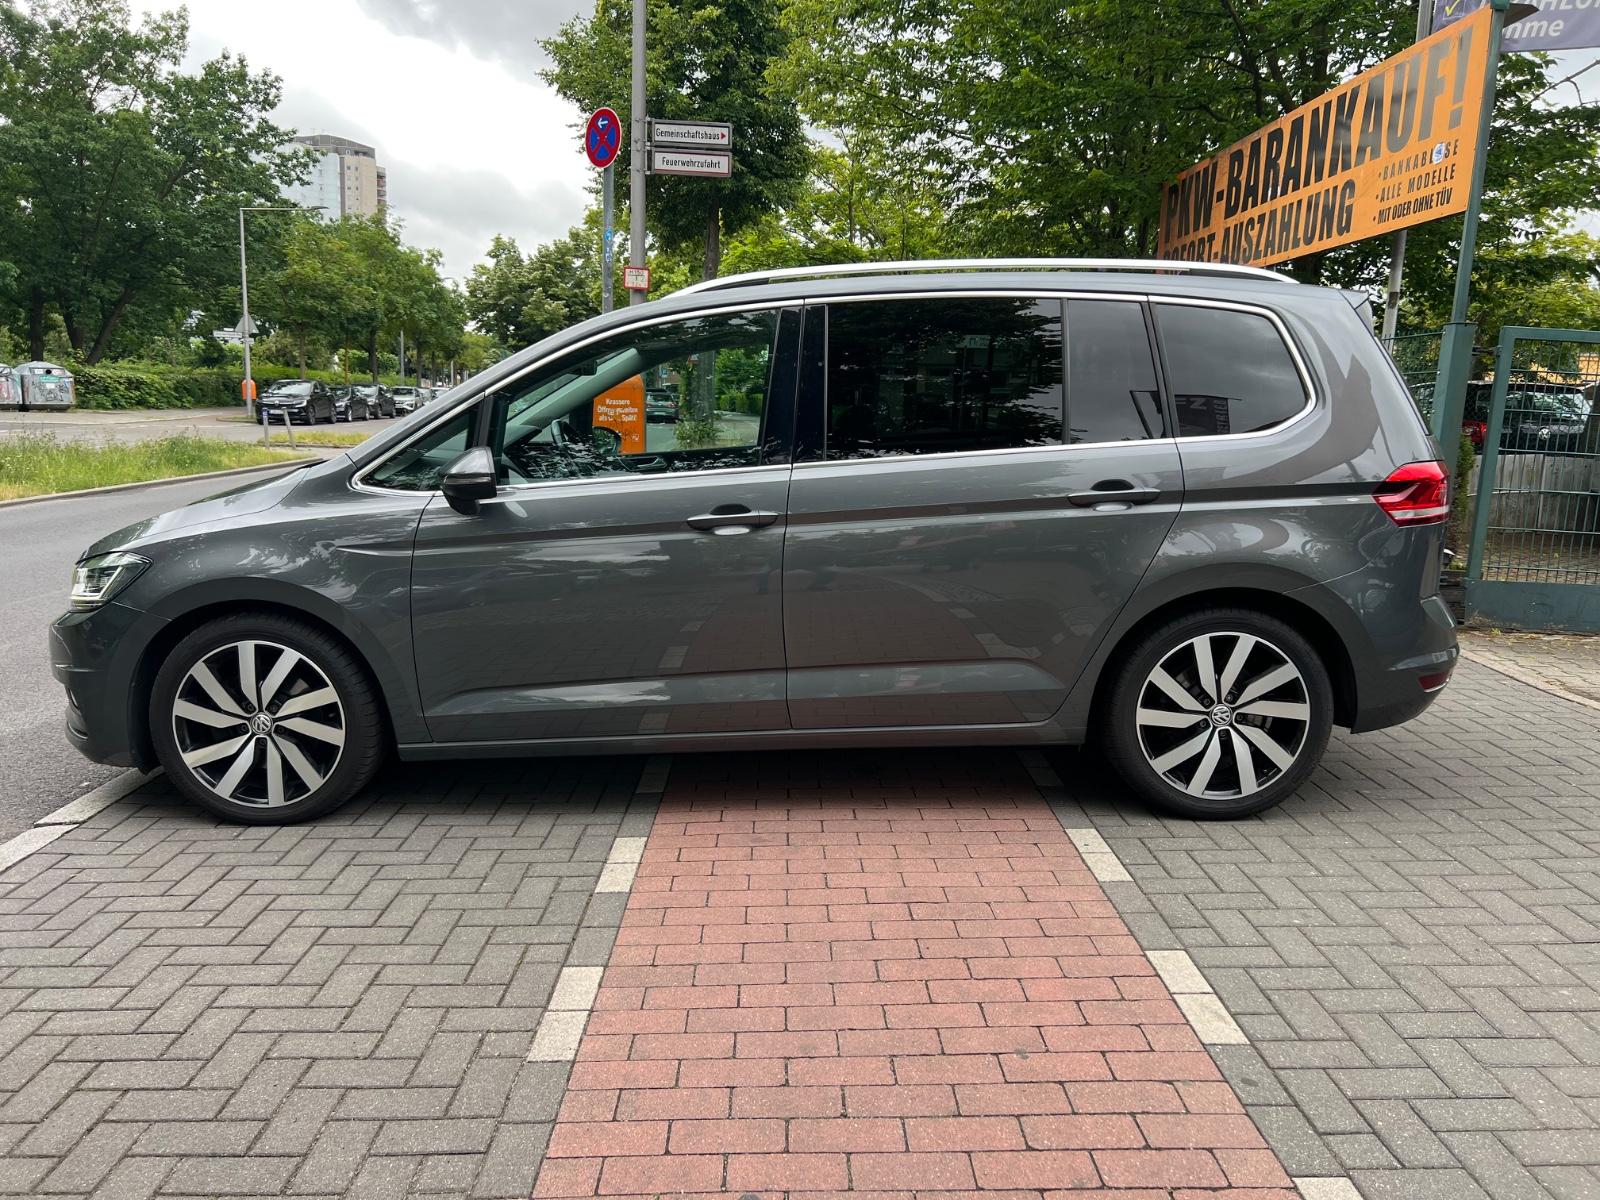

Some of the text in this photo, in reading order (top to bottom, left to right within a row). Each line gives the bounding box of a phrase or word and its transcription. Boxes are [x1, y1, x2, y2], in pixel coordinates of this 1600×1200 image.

[655, 127, 720, 140] Gemeinschaftshaus
[1165, 24, 1473, 243] PKW-BARANKAUF!
[662, 156, 721, 169] Feuerwehrzufahrt
[1383, 138, 1459, 180] BANKABLSE
[1380, 163, 1456, 203] ALLE MODELLE
[1377, 186, 1453, 224] MIT ODER OHNE TÜV
